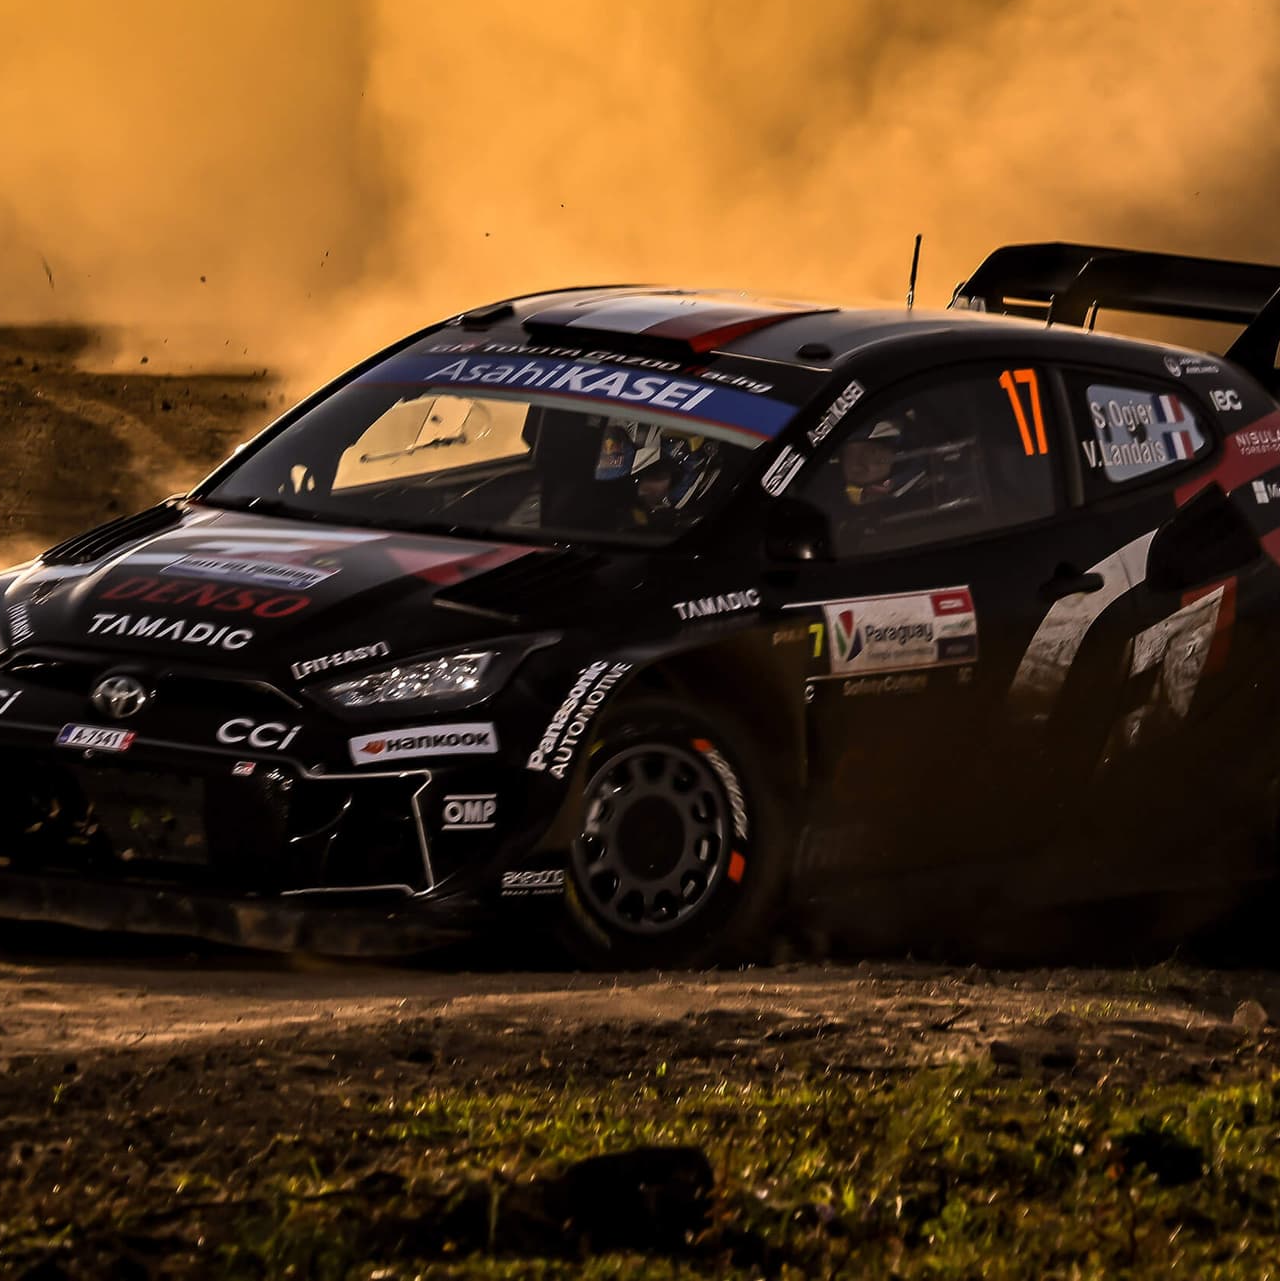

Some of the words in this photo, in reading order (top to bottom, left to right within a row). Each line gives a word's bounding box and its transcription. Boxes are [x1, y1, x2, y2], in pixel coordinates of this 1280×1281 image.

[422, 358, 715, 412] AsahiKASEI
[998, 368, 1049, 456] 17
[97, 575, 312, 619] DENSO
[672, 587, 761, 621] TAMADIC
[86, 613, 255, 651] TAMADIC
[808, 623, 825, 658] 7
[865, 621, 935, 646] Paraguay
[525, 660, 610, 771] Panasonic
[549, 661, 634, 781] AUTOMOTIVE
[442, 799, 498, 824] OMP
